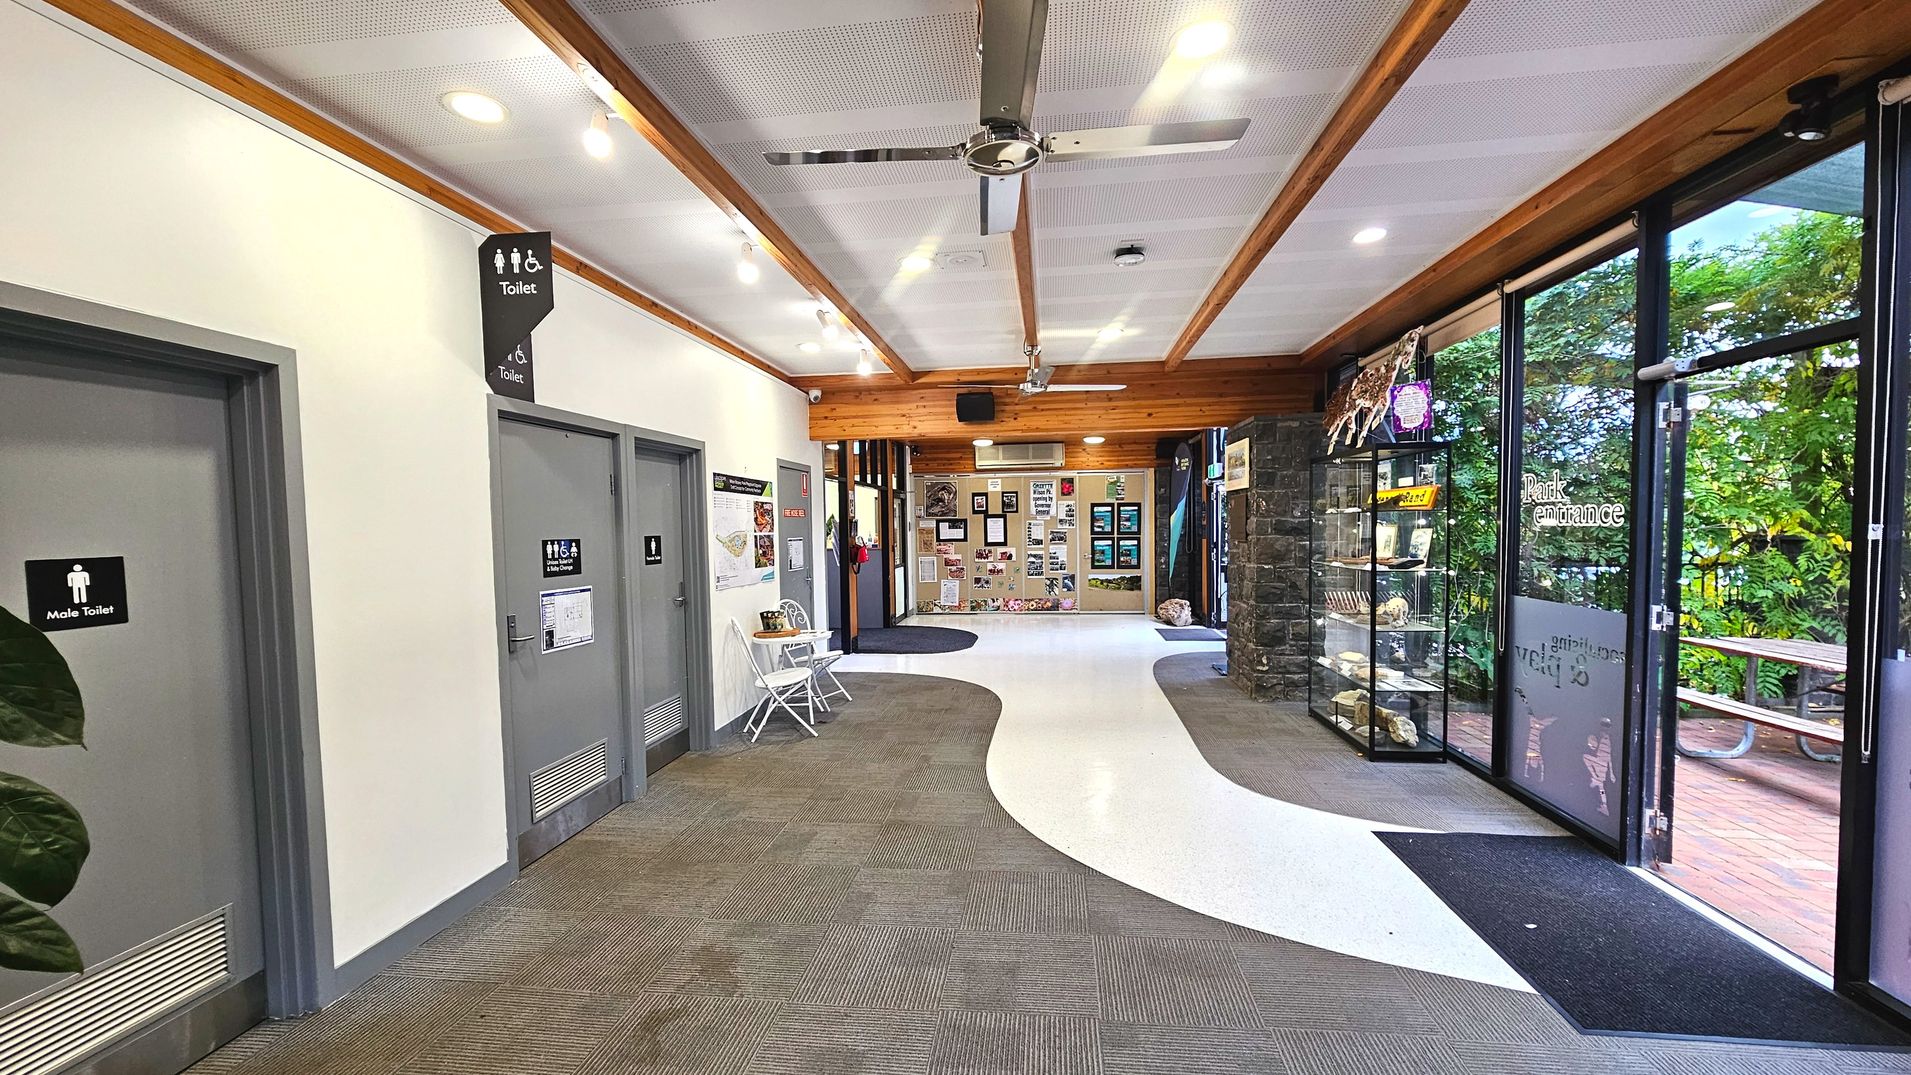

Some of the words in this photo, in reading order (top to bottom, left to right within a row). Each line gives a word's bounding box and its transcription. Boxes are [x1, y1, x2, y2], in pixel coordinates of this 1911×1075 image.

[499, 281, 537, 295] Toilet
[498, 365, 524, 384] Toilet
[1523, 469, 1570, 503] Park
[1533, 503, 1625, 527] entrance
[46, 608, 79, 620] Male
[82, 605, 114, 616] Toilet
